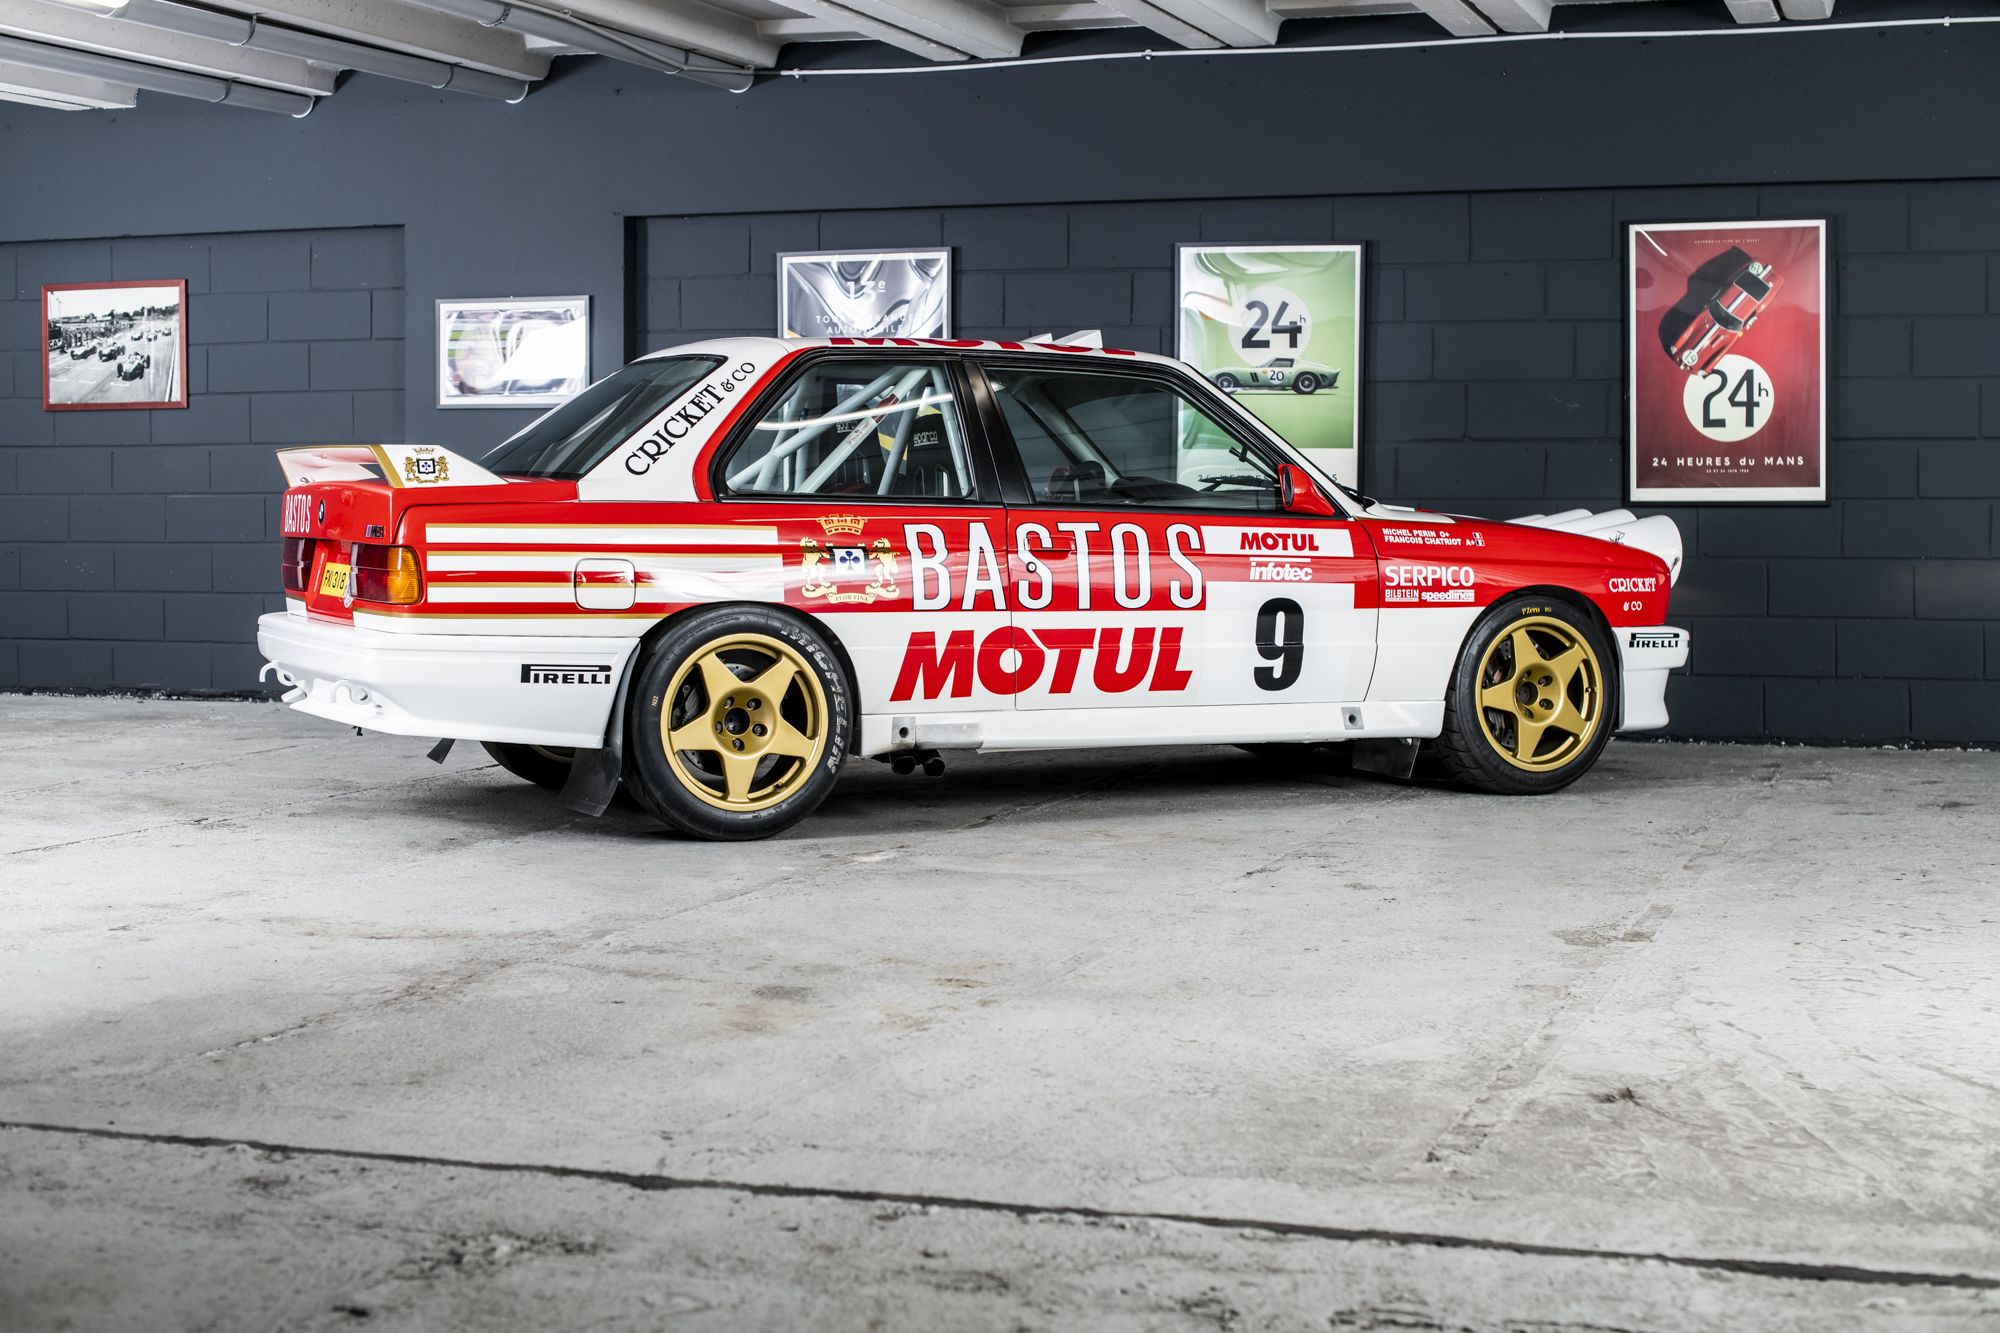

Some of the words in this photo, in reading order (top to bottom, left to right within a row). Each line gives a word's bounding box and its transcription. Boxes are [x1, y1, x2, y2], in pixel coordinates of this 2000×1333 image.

[1269, 369, 1285, 382] 20
[625, 384, 724, 476] CRICKET
[720, 379, 735, 392] &
[731, 362, 756, 382] CO
[914, 431, 938, 444] sparco
[1652, 457, 1668, 467] 24
[1677, 456, 1731, 467] HEURES
[1739, 456, 1755, 466] du
[1764, 456, 1804, 466] MANS
[284, 494, 312, 533] BASTOS
[1240, 532, 1319, 551] MOTUL
[1382, 528, 1412, 537] MICHEL
[1413, 529, 1436, 538] PERIN
[1384, 536, 1423, 545] FRANCOIS
[1424, 538, 1462, 546] CHATRIOT
[903, 522, 1204, 611] BASTOS
[1250, 562, 1312, 581] infotec
[332, 571, 347, 590] 318
[1385, 566, 1475, 587] SERPICO
[1609, 577, 1657, 593] CRICKET
[835, 594, 852, 602] FLOR
[853, 594, 868, 602] FINA
[1385, 589, 1419, 598] BILSTEIN
[1421, 589, 1471, 601] speedline
[1622, 602, 1630, 612] &
[1630, 601, 1643, 611] CO
[1254, 597, 1304, 692] 9
[1629, 632, 1680, 648] PIRELLI
[889, 626, 1193, 702] MOTUL
[521, 664, 612, 684] PIRELLI
